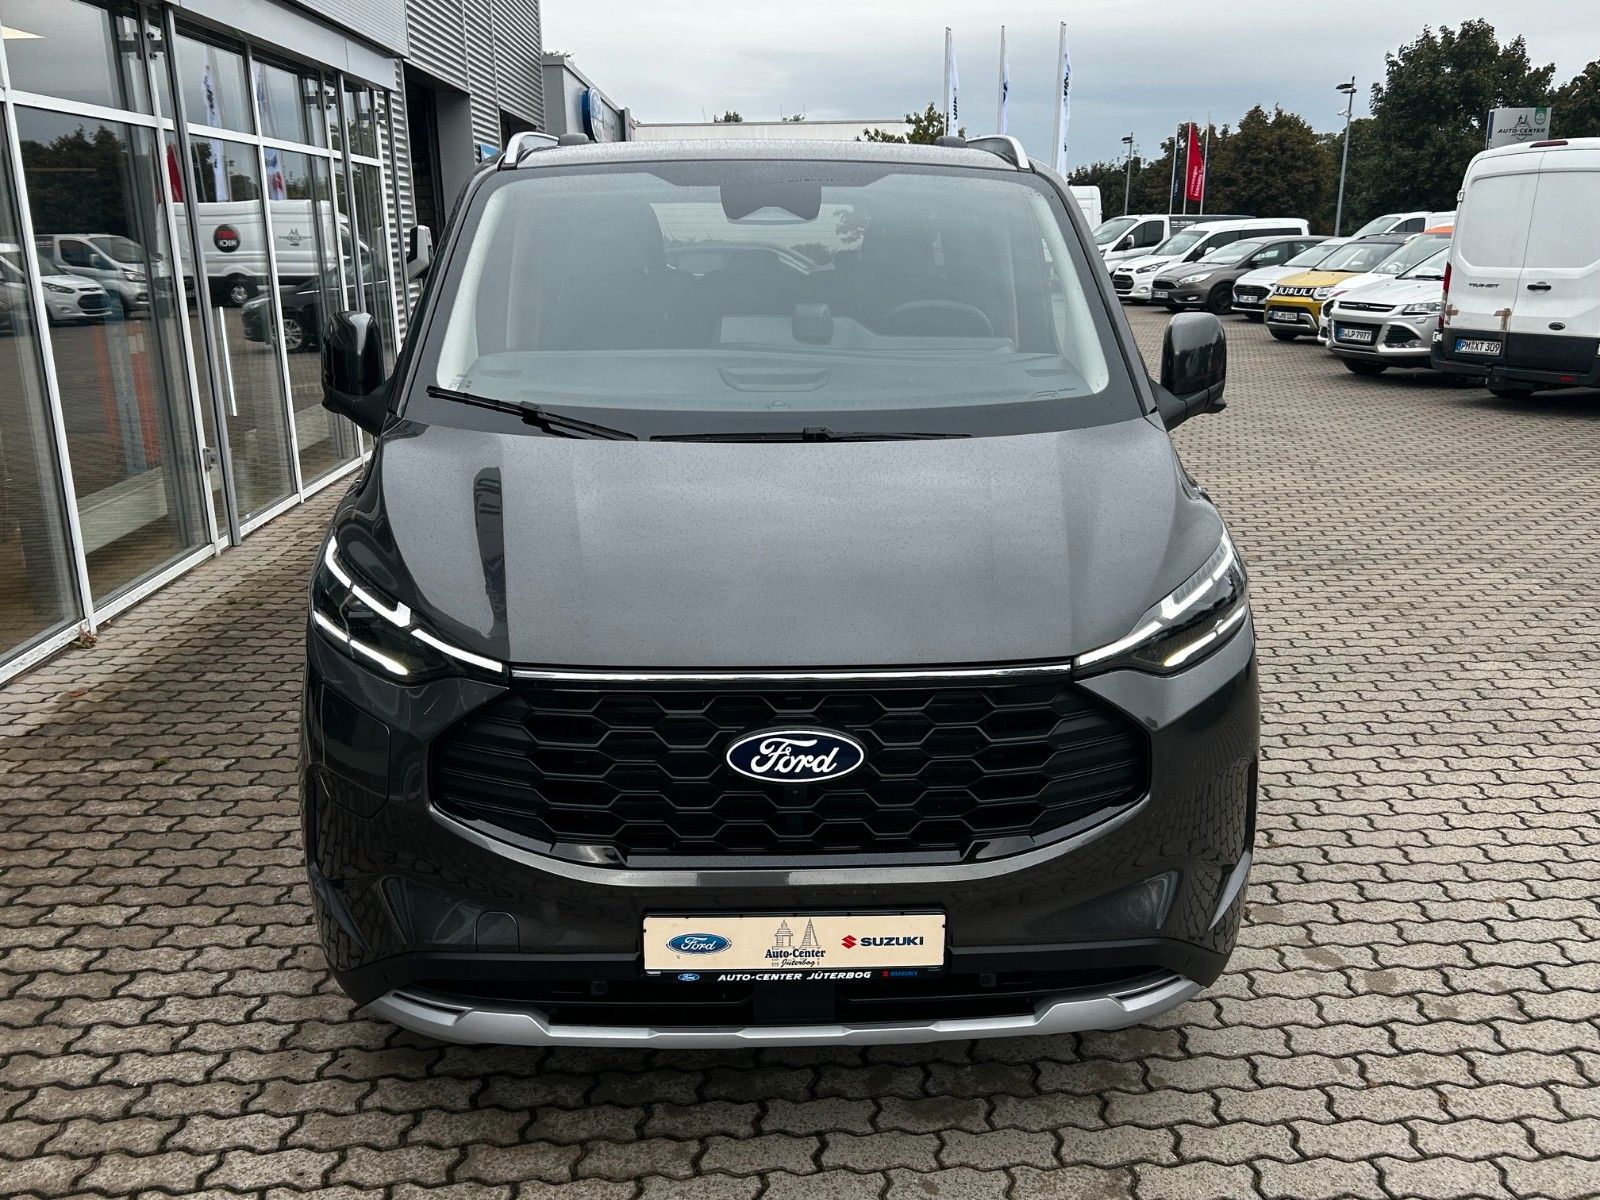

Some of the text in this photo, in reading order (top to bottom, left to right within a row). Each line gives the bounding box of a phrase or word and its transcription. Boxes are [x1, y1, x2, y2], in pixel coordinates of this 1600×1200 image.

[1356, 331, 1371, 340] 7977
[1485, 342, 1500, 352] 309
[751, 738, 840, 773] Ford
[680, 936, 717, 951] Ford
[860, 936, 924, 946] SUZUKI
[765, 948, 826, 959] Auto-Center
[717, 971, 872, 982] AUTO-CENTER JÜTERBOG
